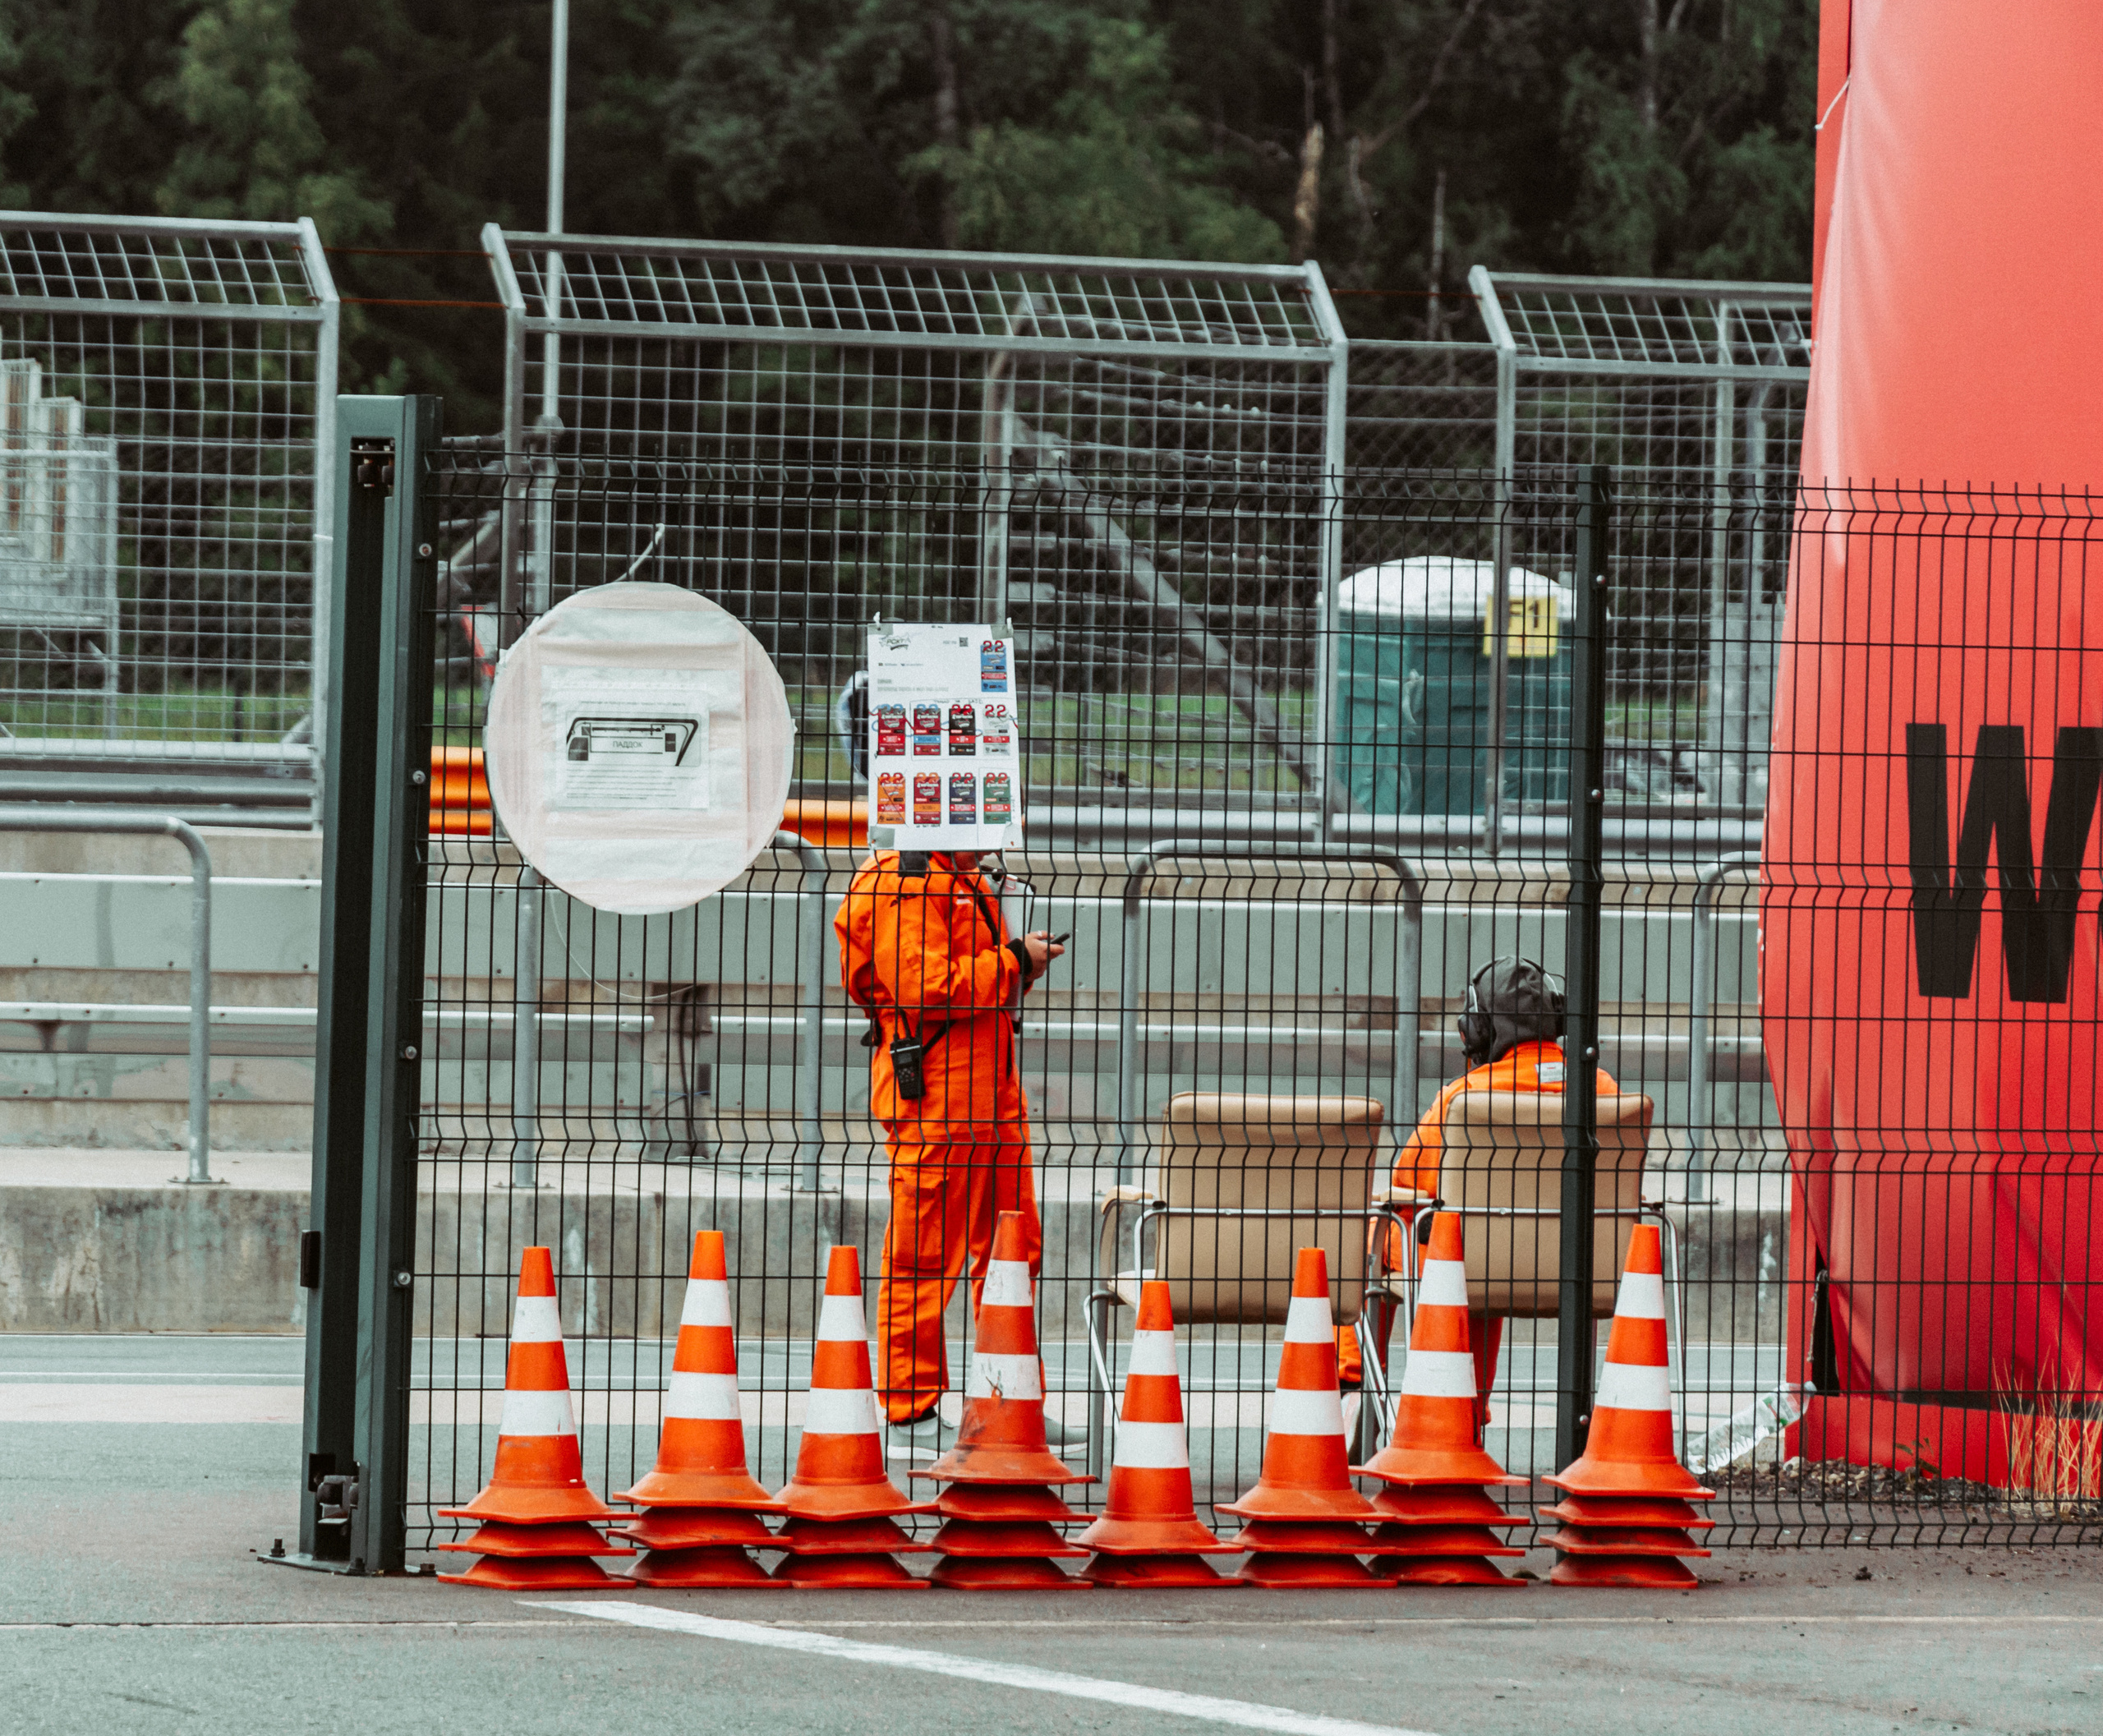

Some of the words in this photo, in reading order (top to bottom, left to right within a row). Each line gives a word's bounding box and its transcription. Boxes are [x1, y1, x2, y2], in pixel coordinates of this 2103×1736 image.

[984, 704, 1006, 717] 22
[612, 740, 643, 748] ПАДДОК
[1905, 723, 2103, 1004] W
